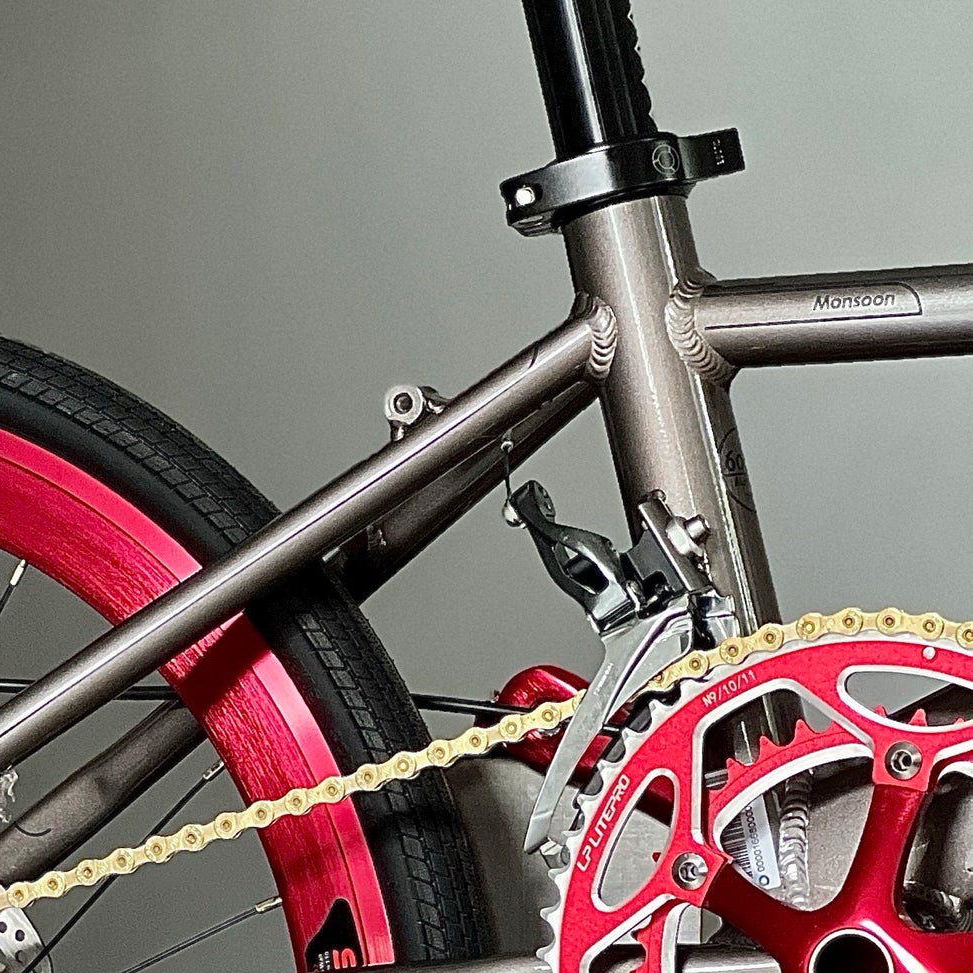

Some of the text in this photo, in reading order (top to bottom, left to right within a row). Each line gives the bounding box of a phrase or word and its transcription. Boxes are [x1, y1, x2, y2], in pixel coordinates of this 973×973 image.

[813, 292, 896, 312] Monsoon
[701, 669, 756, 708] N9/10/11
[576, 774, 631, 872] LP LITEPRO
